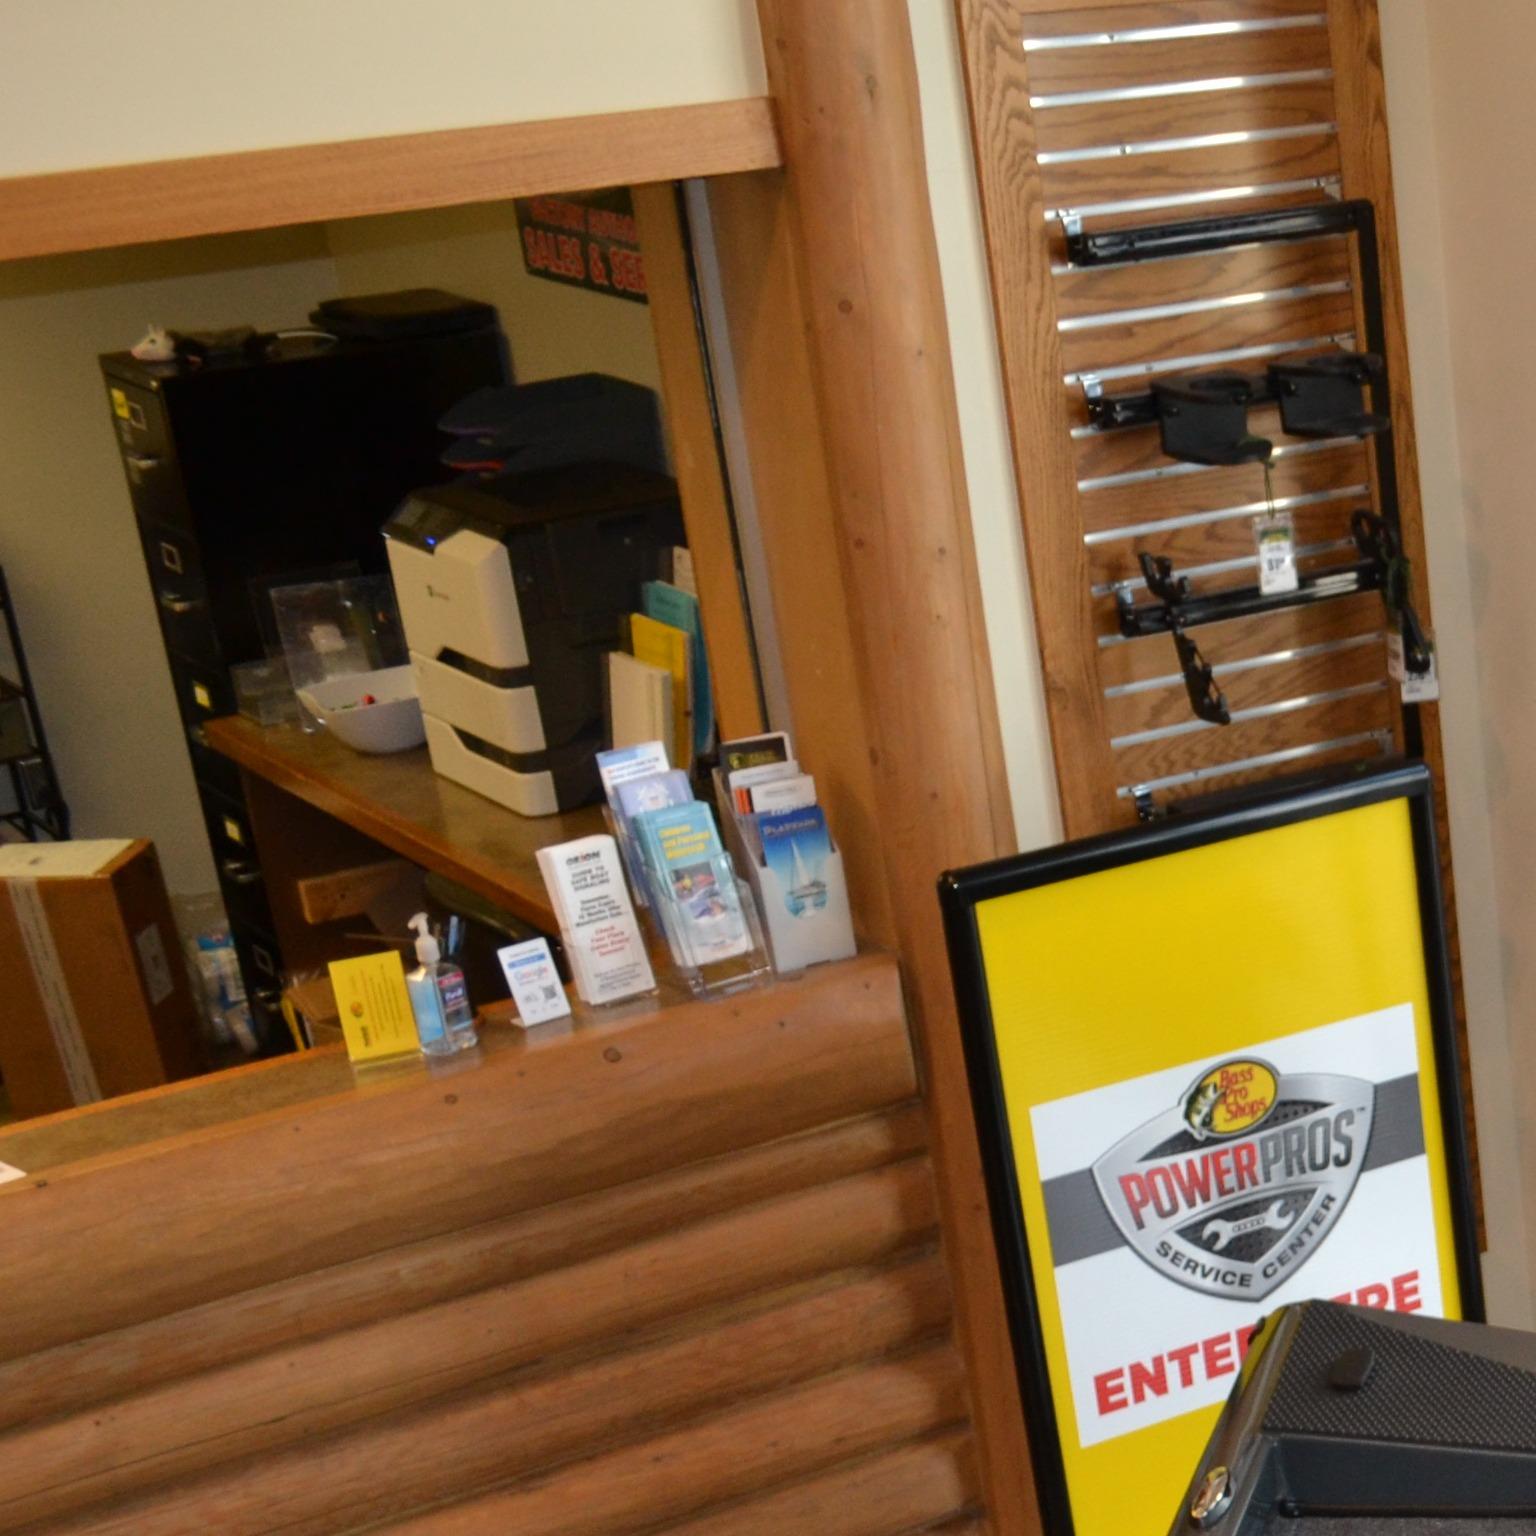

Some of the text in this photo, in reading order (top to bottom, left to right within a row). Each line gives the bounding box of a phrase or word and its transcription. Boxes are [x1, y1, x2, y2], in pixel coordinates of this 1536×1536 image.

[523, 226, 586, 280] SALES
[588, 242, 610, 286] &
[566, 850, 600, 866] ORION
[1220, 1065, 1254, 1088] Bass
[1223, 1087, 1248, 1105] Pro
[1224, 1097, 1267, 1122] Shops
[1155, 1193, 1336, 1288] SERVICE CENTER
